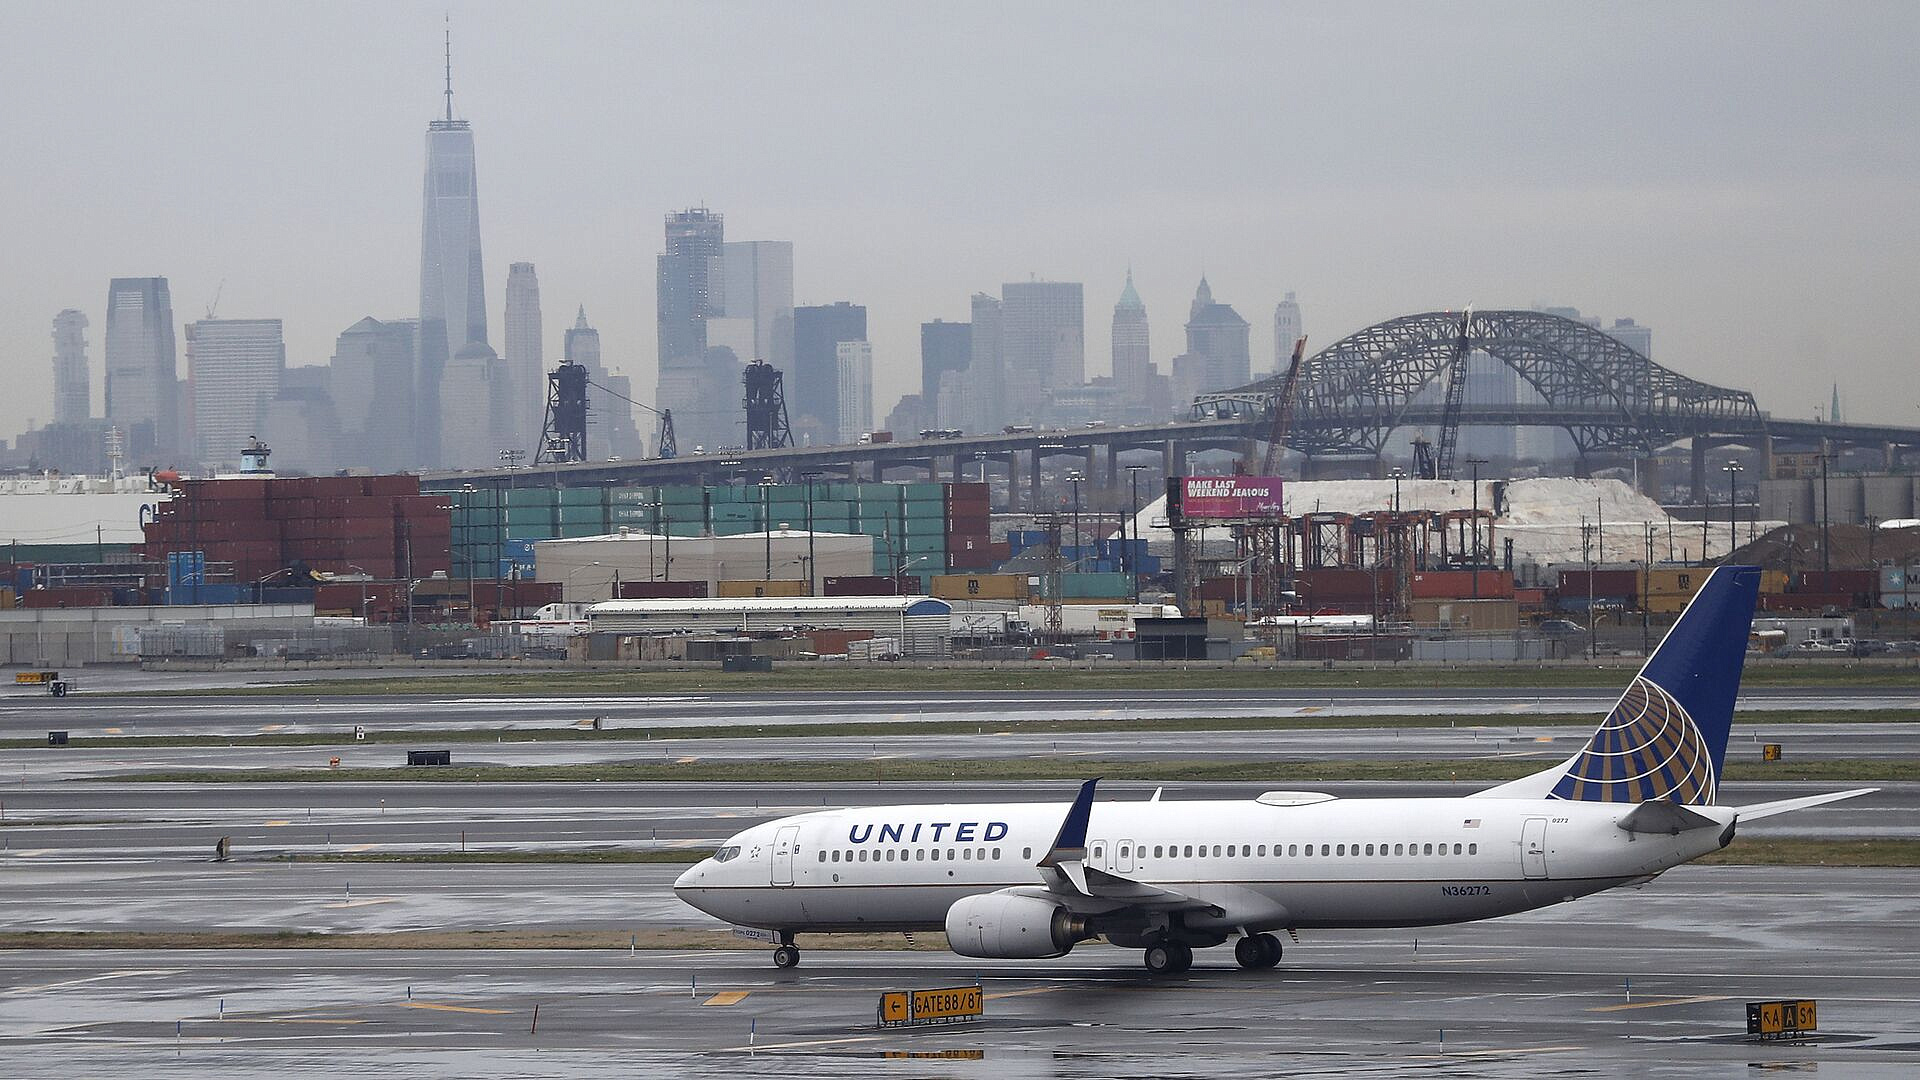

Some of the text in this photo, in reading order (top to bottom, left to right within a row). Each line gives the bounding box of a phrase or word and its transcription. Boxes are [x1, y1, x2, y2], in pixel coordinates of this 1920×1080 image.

[1187, 480, 1236, 489] MAKE LAST
[1188, 488, 1269, 498] WEEKEND JEALOUS
[849, 822, 1009, 844] UNITED
[1441, 886, 1491, 897] N36272
[745, 929, 760, 938] 0272
[1772, 1007, 1806, 1027] A A S
